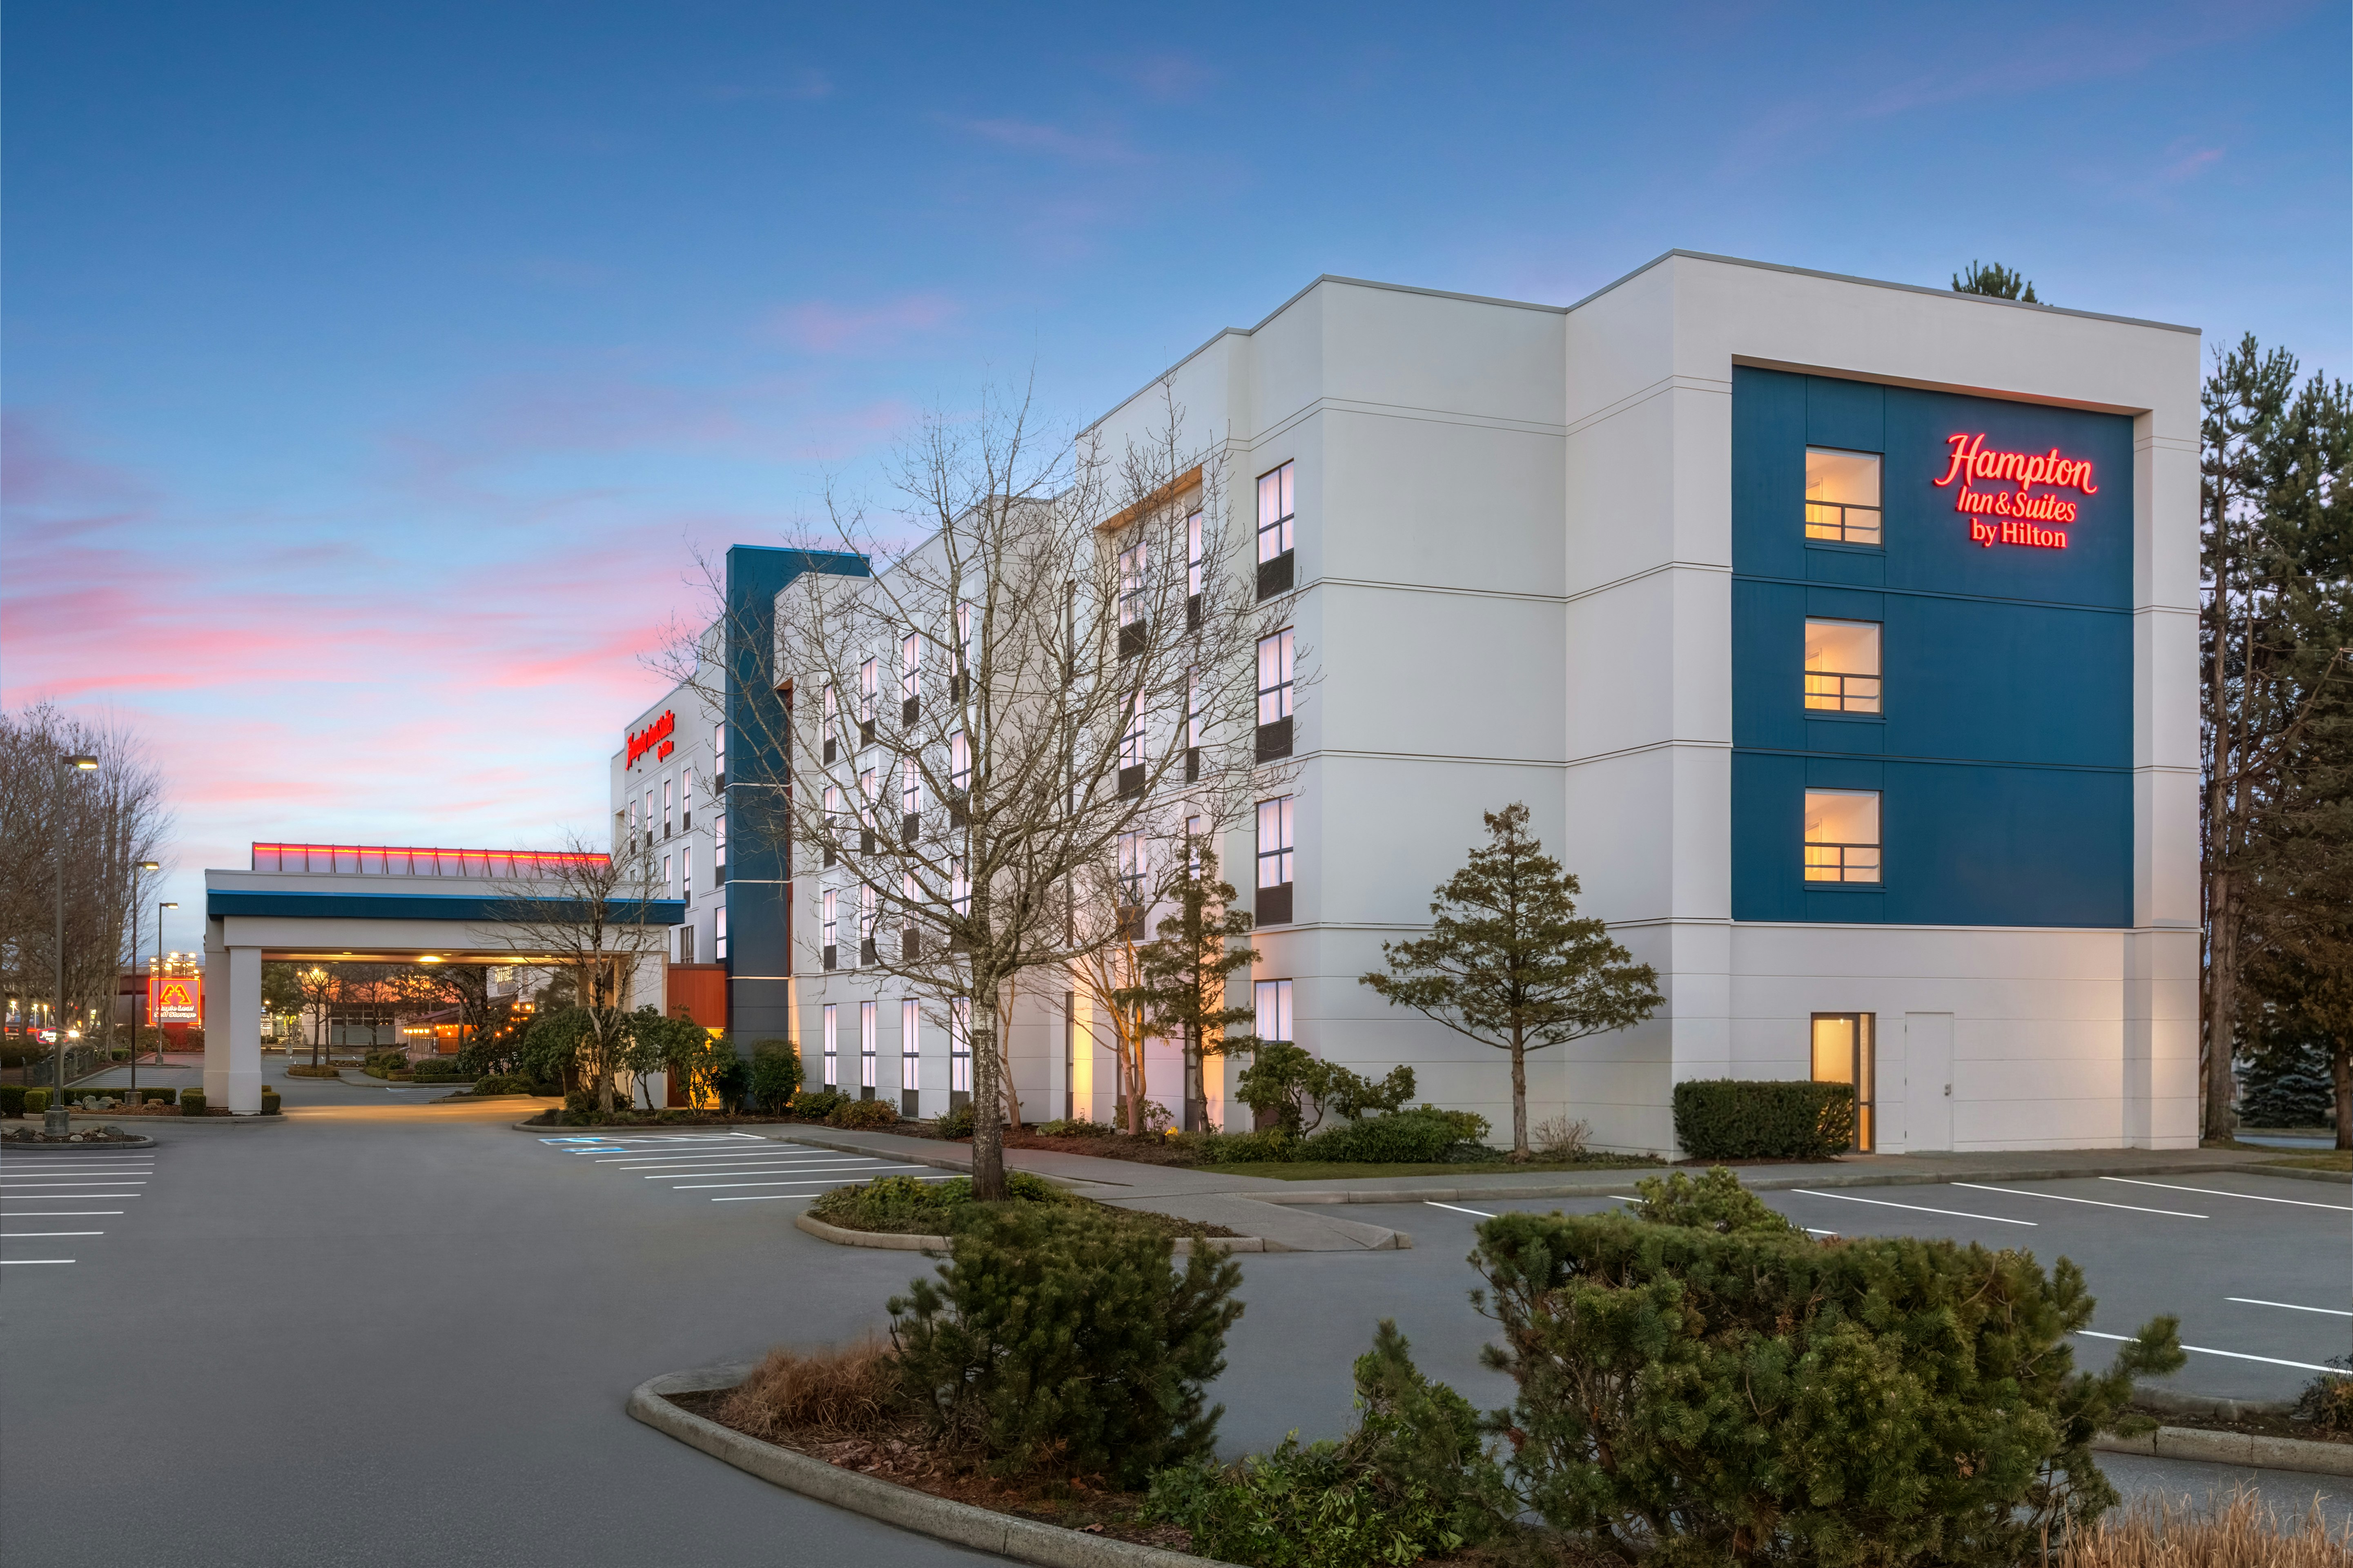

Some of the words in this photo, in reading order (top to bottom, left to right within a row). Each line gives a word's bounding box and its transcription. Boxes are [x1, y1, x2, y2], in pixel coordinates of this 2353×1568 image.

[1933, 433, 2098, 494] Hampton
[1956, 486, 1993, 513] Inn
[2012, 492, 2076, 522] Suites
[1970, 517, 1998, 548] by
[1999, 521, 2067, 548] Hilton
